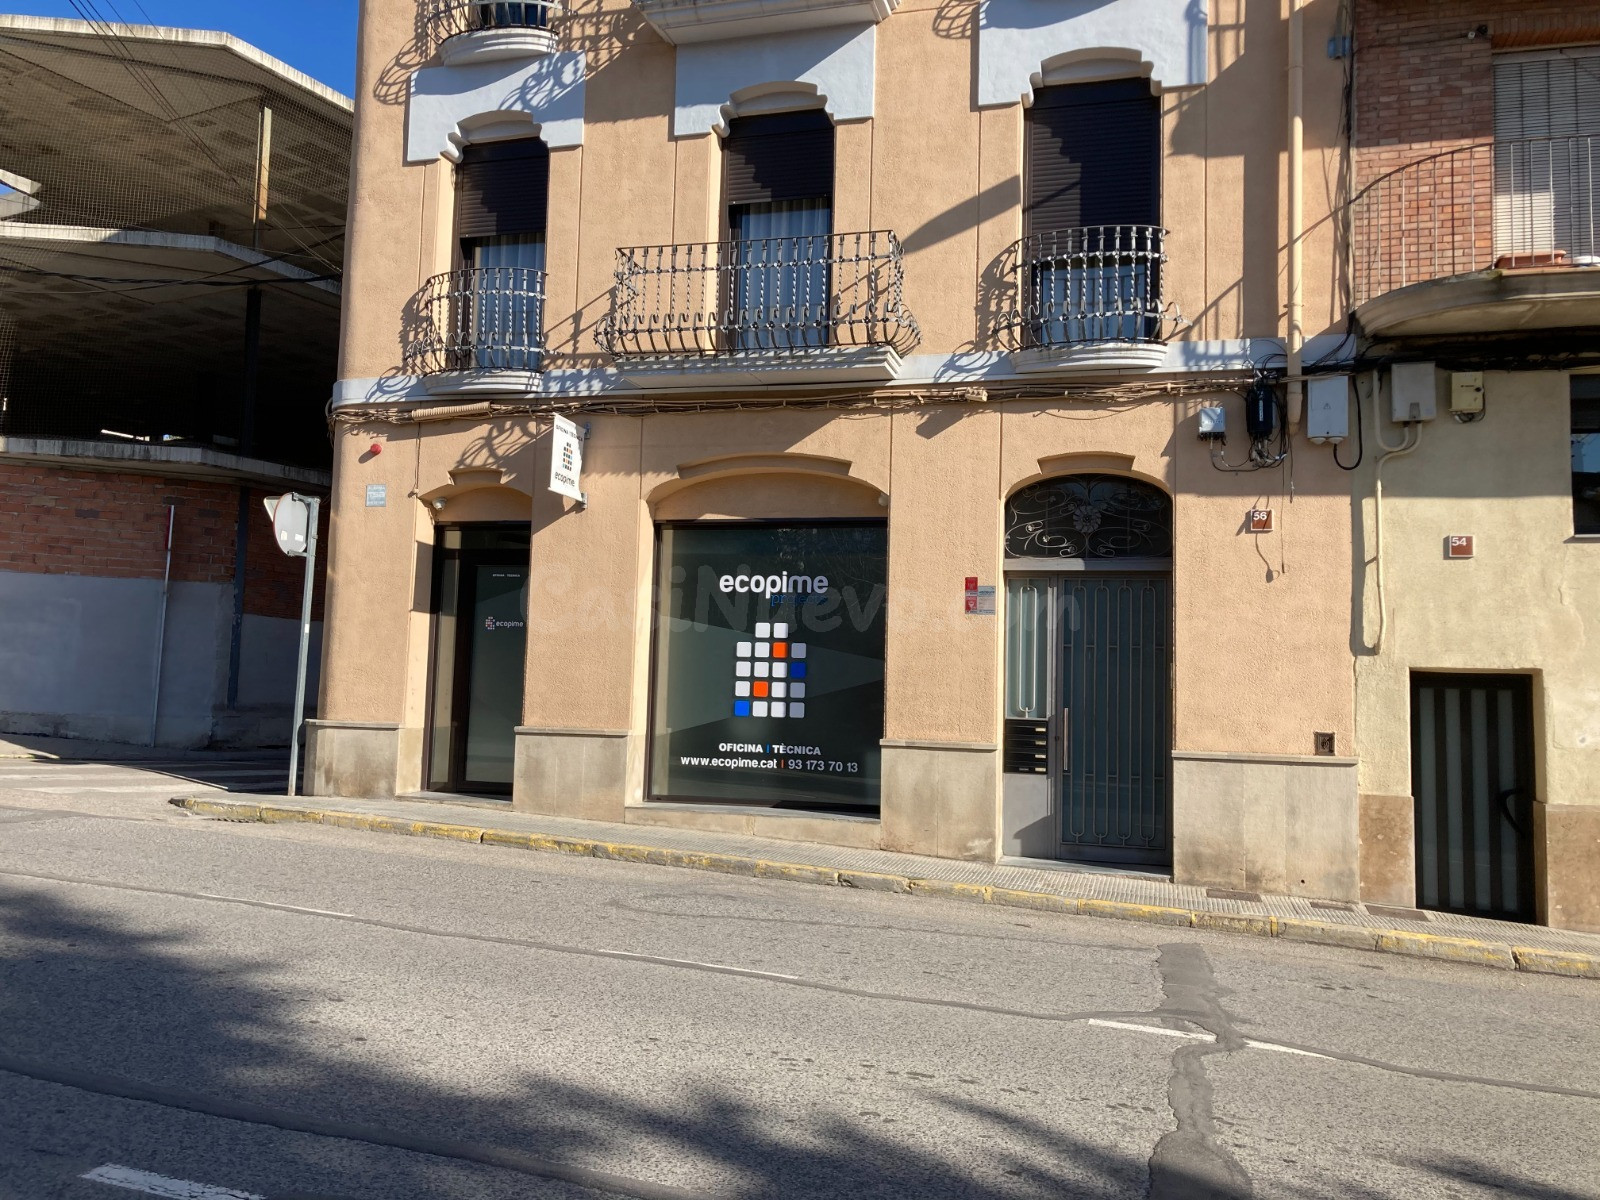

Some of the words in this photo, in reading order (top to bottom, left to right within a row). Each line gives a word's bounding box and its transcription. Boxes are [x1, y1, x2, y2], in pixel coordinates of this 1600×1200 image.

[554, 471, 575, 487] ecopime
[1253, 511, 1267, 521] 56
[1451, 537, 1467, 547] 54
[719, 571, 829, 599] ecopime
[495, 620, 524, 629] ecopime
[718, 742, 764, 753] OFICINA
[772, 743, 822, 756] TÈCNICA
[680, 756, 778, 769] www.ecopime.cat
[788, 759, 803, 770] 93
[805, 760, 825, 771] 173
[828, 761, 843, 772] 70
[846, 762, 859, 773] 13
